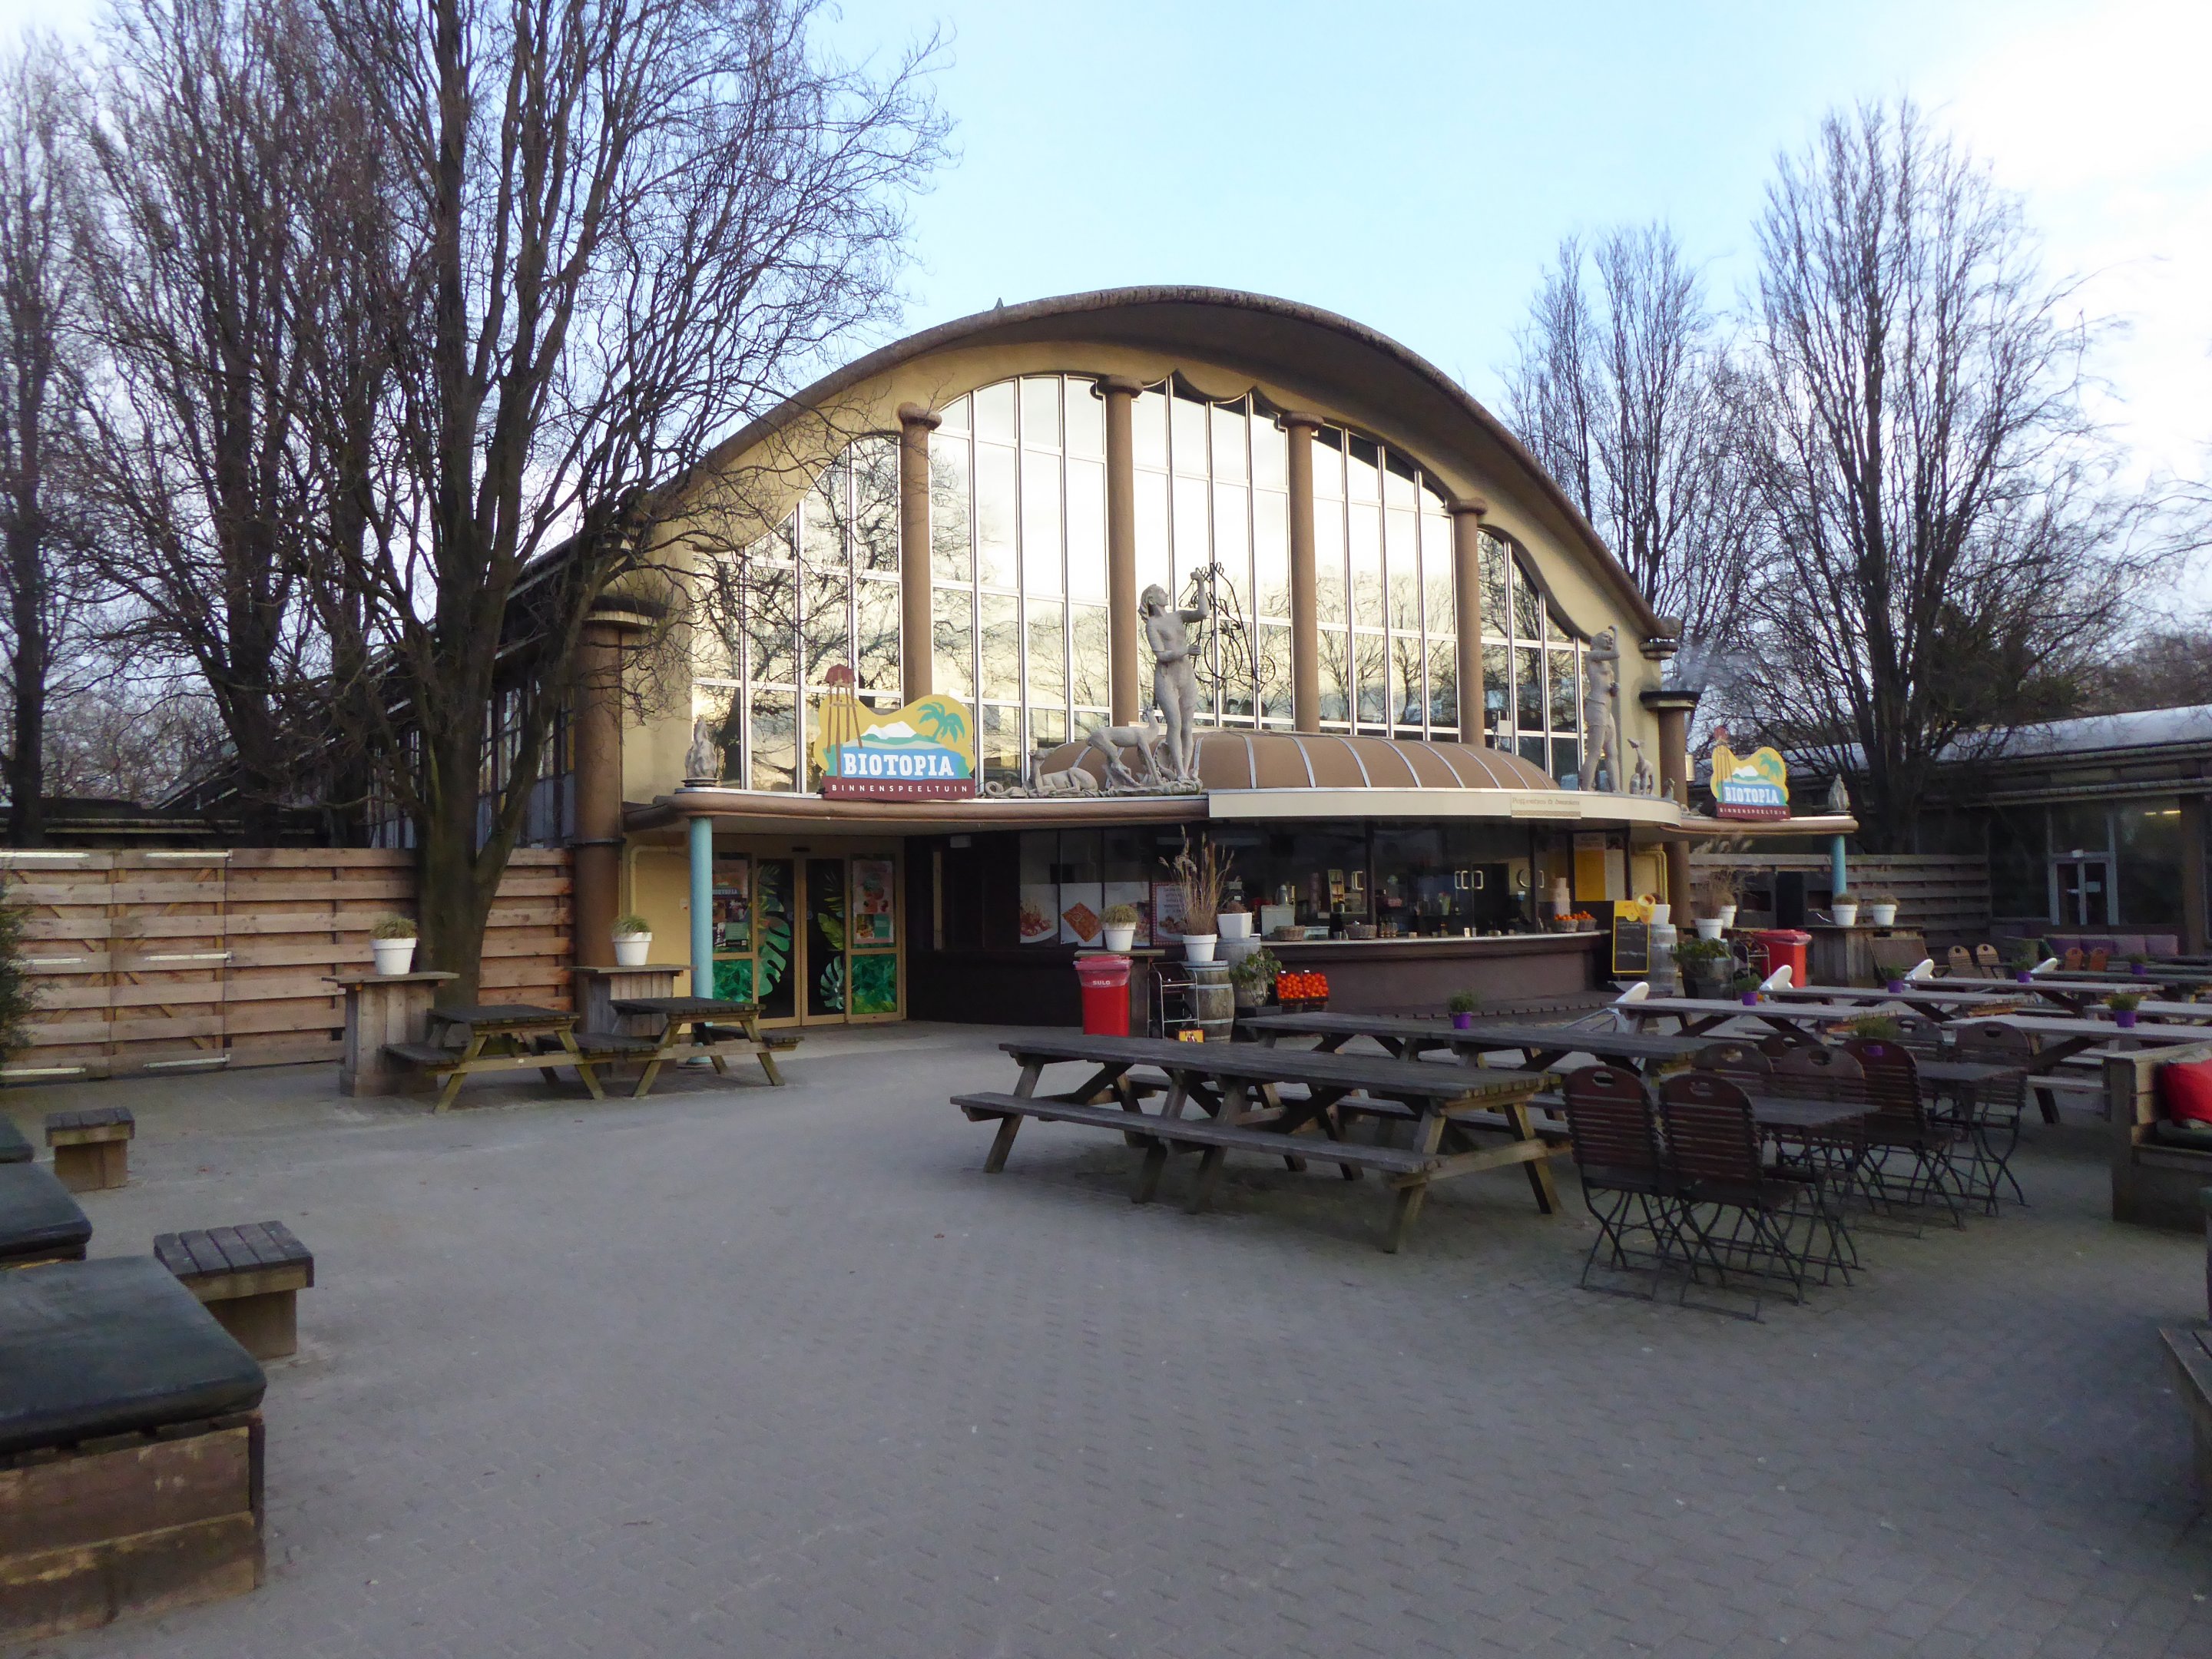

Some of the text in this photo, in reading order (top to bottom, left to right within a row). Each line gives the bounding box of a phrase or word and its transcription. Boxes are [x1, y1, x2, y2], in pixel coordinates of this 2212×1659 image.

[843, 753, 955, 777] BIOTOPIA
[832, 784, 968, 793] BINNENSPEELTUIN
[1724, 786, 1780, 804] BIOTOPIA
